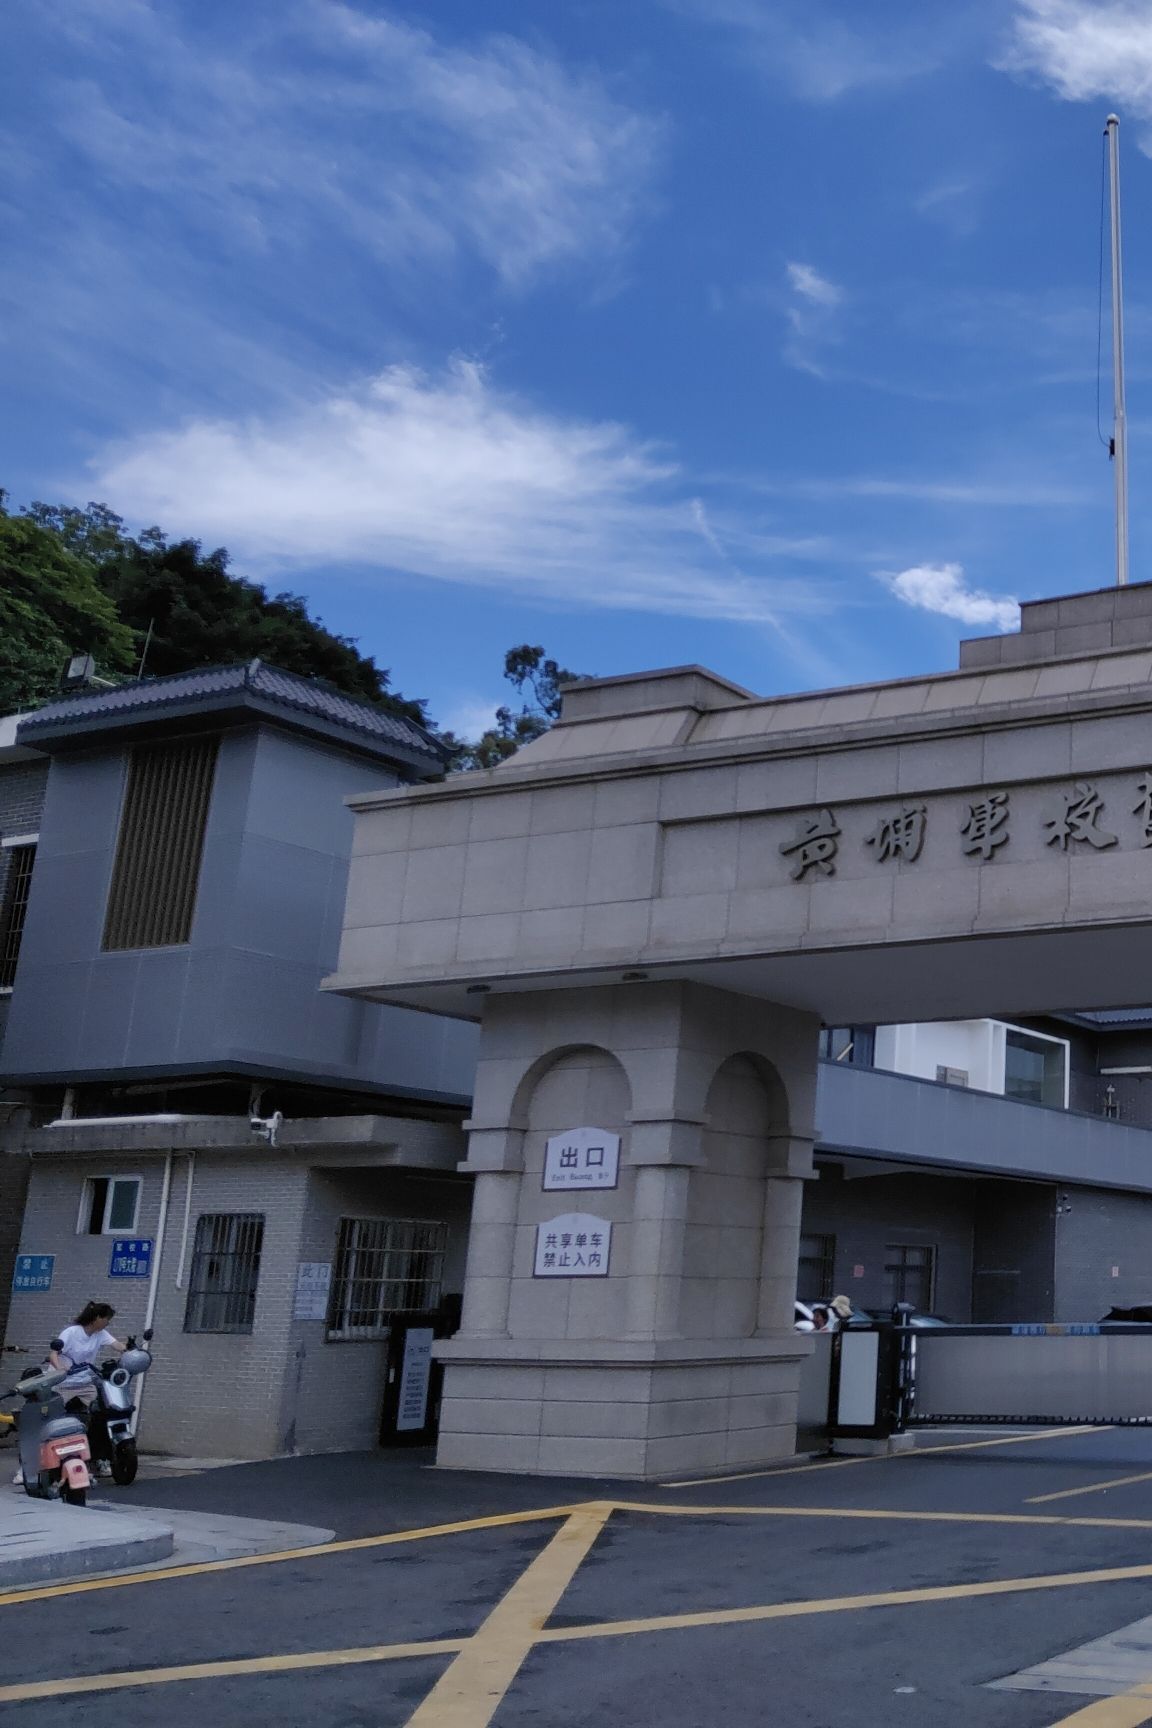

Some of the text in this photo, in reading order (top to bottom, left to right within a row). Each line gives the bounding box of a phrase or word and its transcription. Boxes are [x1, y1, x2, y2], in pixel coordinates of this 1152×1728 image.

[560, 1146, 604, 1168] 出口
[545, 1233, 603, 1249] 共享单车
[543, 1252, 602, 1268] 禁止入内
